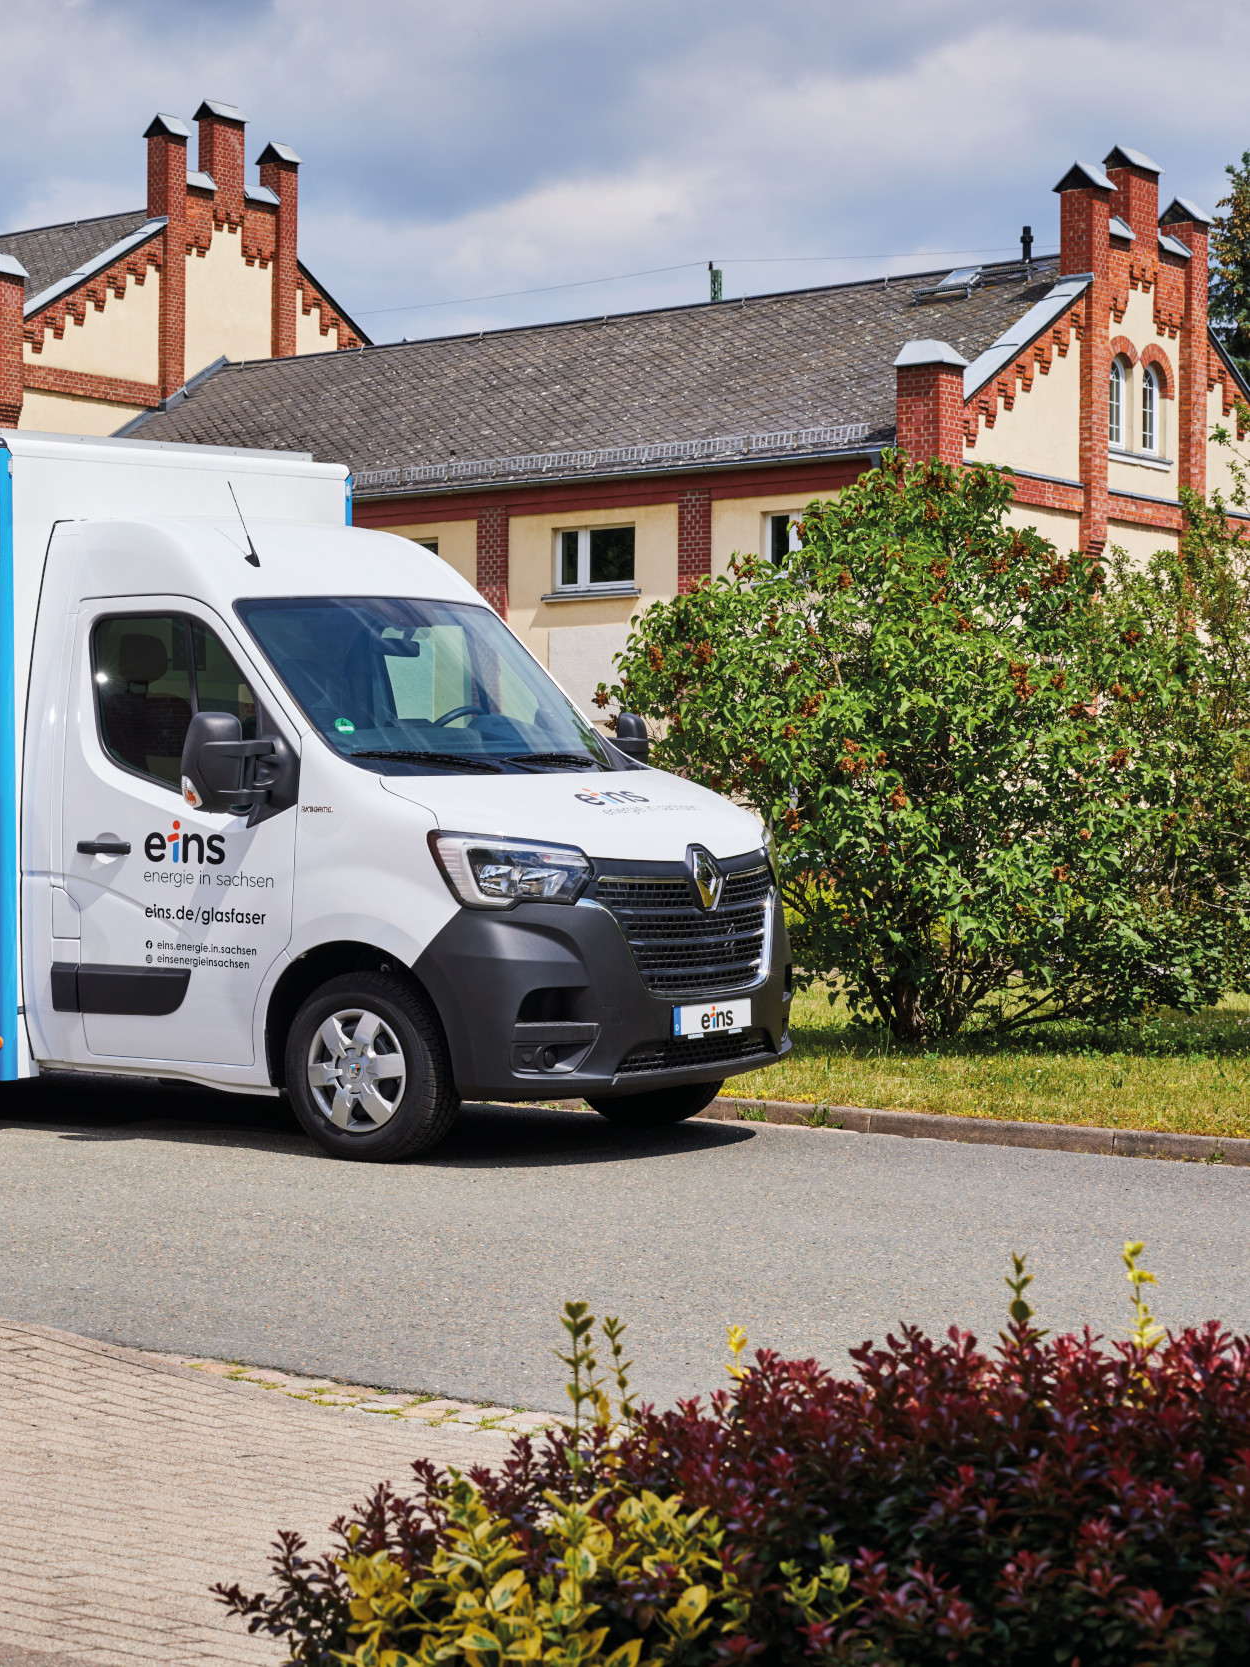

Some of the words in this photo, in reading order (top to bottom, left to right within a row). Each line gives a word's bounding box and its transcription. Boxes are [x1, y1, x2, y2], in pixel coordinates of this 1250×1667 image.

[574, 787, 650, 806] eins
[144, 820, 226, 865] eins
[143, 870, 194, 888] energie
[199, 870, 211, 885] in
[216, 870, 275, 889] sachsen
[144, 903, 267, 926] eins.de/glasfaser
[157, 940, 257, 956] eins.energie.in.sachsen
[157, 954, 250, 970] einsenergieinsachsen
[701, 1005, 734, 1030] eins
